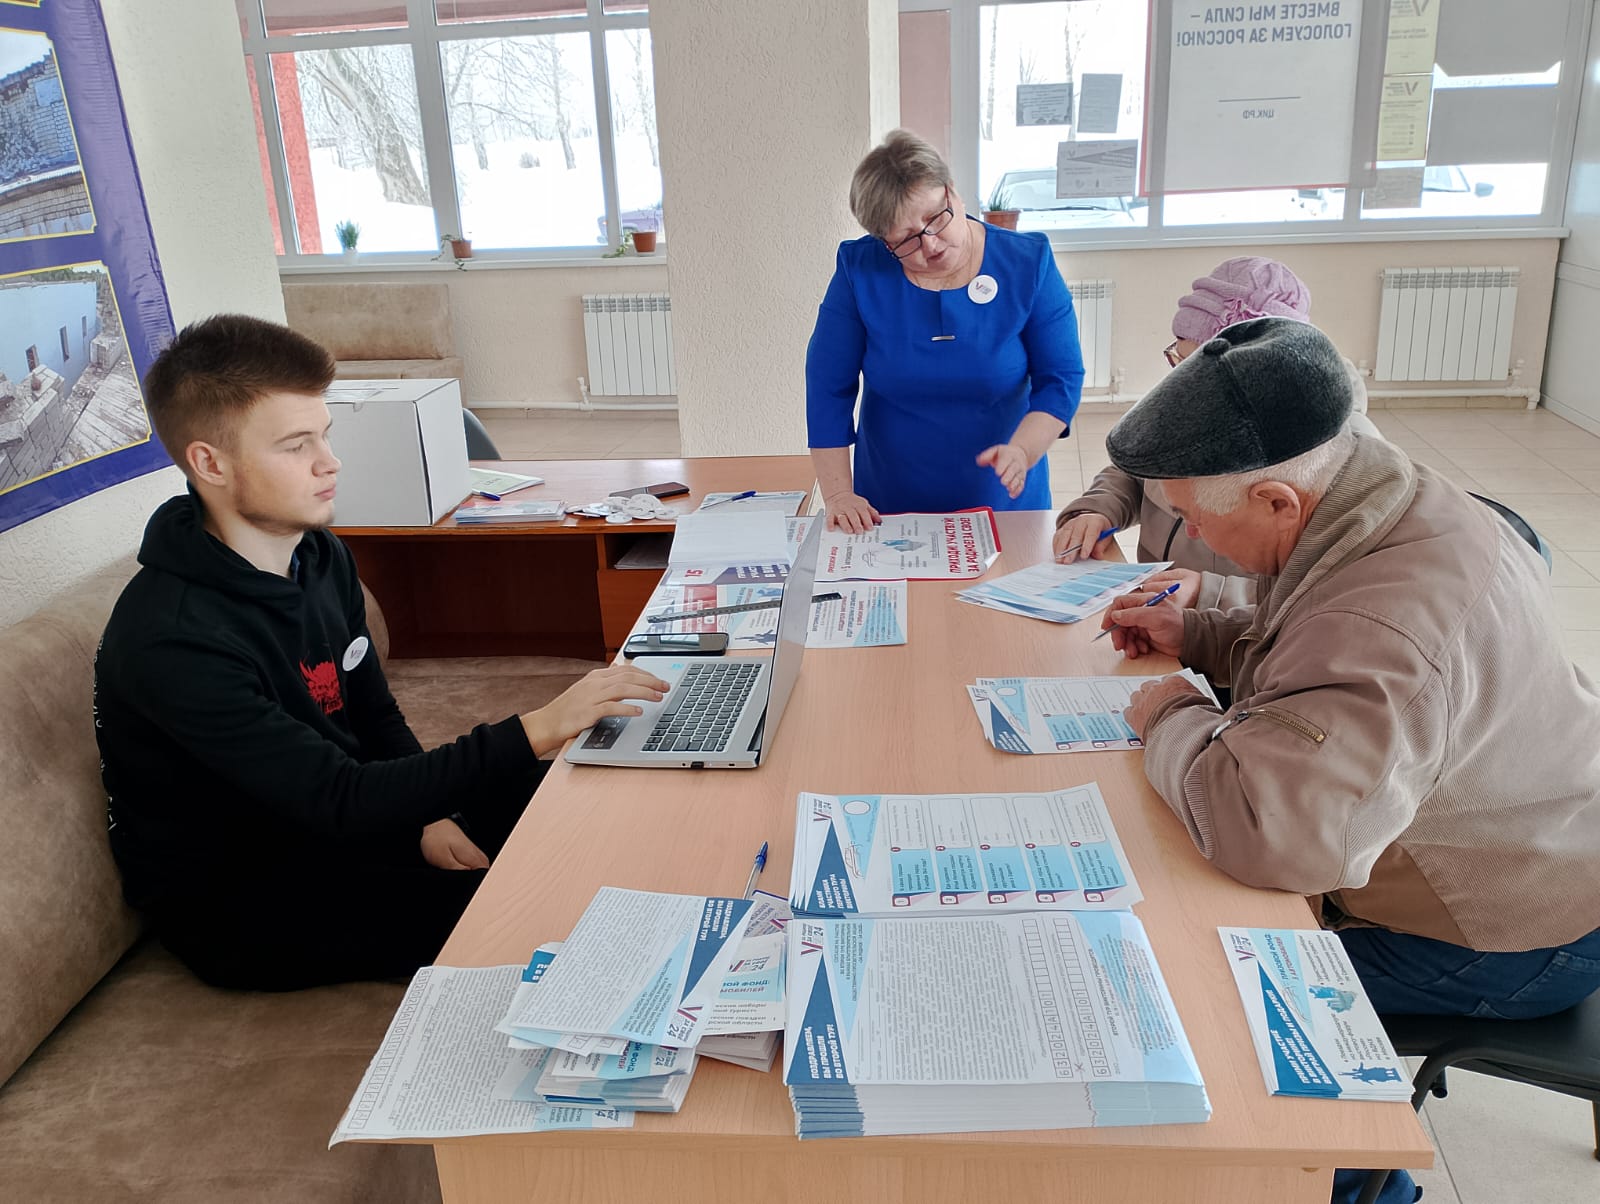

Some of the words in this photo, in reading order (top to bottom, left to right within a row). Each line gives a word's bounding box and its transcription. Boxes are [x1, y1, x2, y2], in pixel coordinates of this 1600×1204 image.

[963, 532, 974, 540] ЗА
[968, 564, 980, 573] ЗА
[752, 964, 765, 972] 24
[666, 1023, 680, 1038] 24
[826, 1024, 837, 1039] ТУР!
[1271, 1030, 1294, 1060] УЧАСТИЕ
[1291, 1028, 1311, 1051] ПРИЗЫ
[803, 1026, 820, 1079] ПОЗДРАВЛЯЕМ,
[816, 1035, 830, 1066] ПРОШЛИ
[828, 1039, 842, 1067] ВТОРОЙ
[655, 1057, 665, 1066] 24
[1306, 1052, 1333, 1084] ВЫИГРАЙ
[821, 1066, 832, 1079] ВЫ
[834, 1068, 845, 1079] ВО
